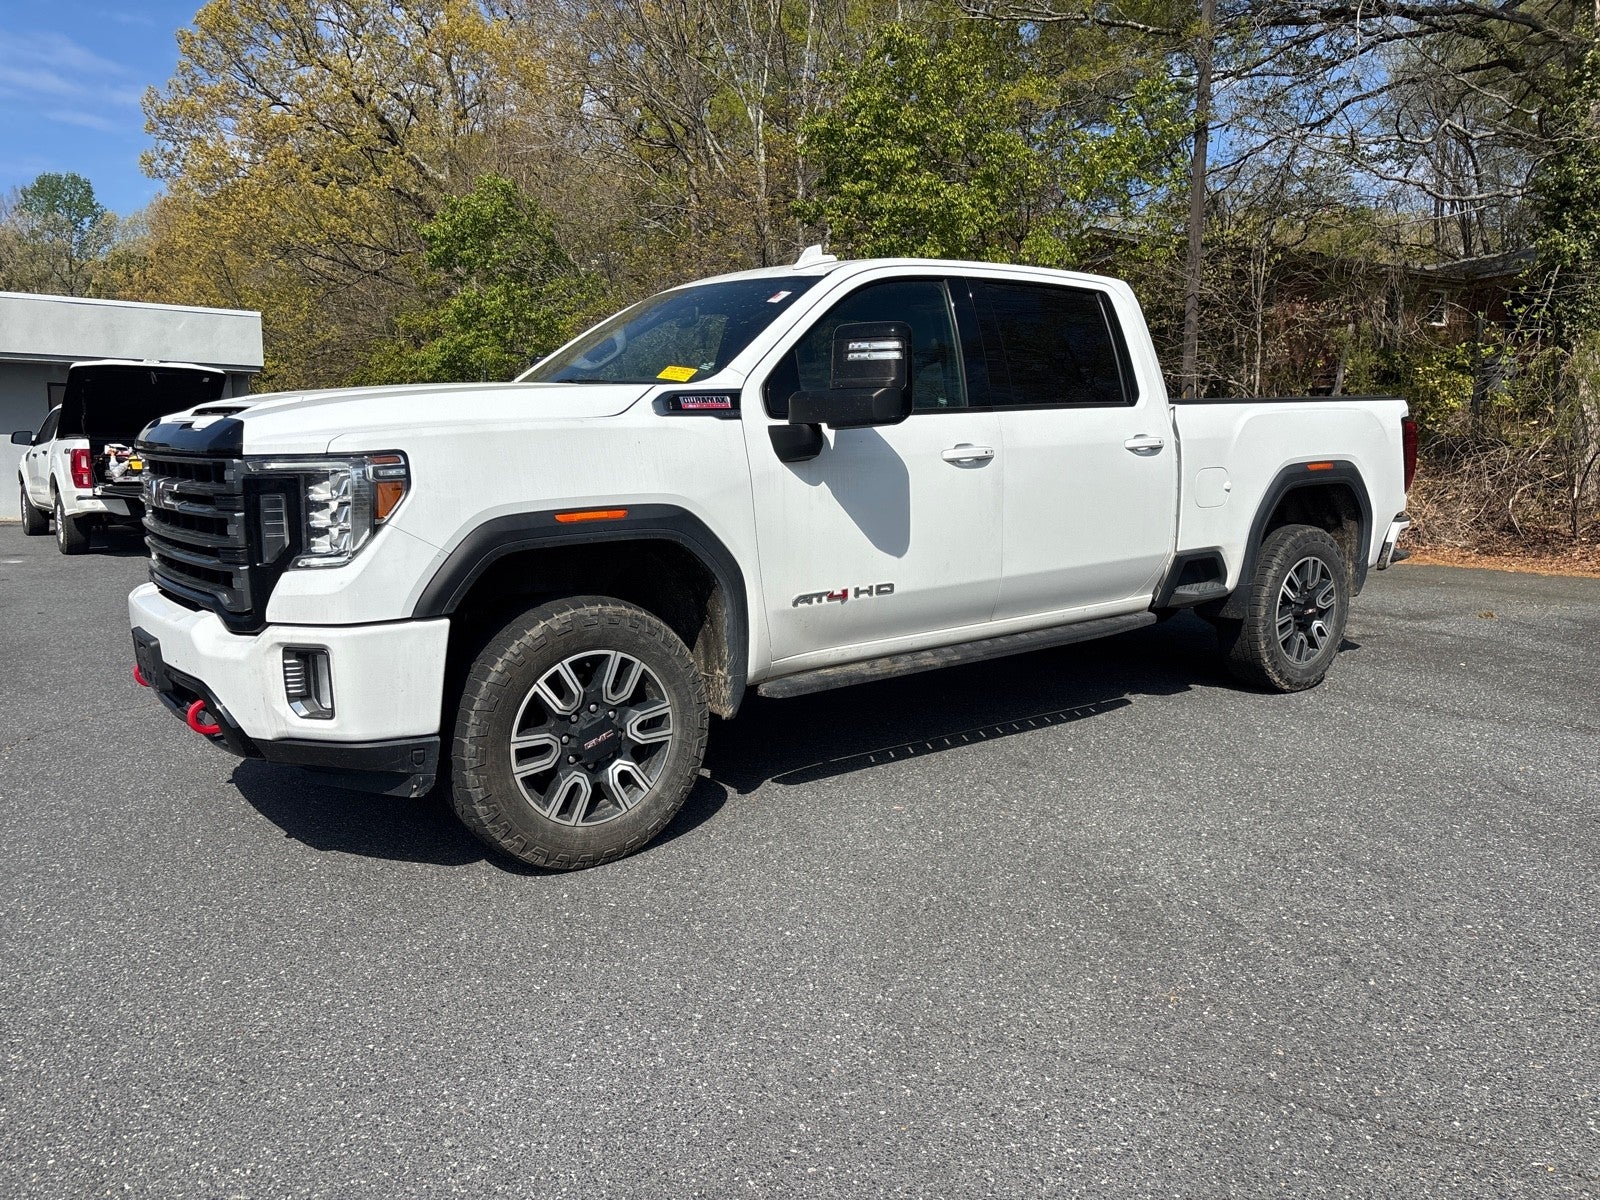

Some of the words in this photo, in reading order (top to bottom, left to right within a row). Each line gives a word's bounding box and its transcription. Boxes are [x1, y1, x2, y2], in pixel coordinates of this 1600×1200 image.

[682, 396, 727, 404] DURAMAX
[792, 588, 848, 608] AT4
[854, 583, 895, 599] HD
[583, 729, 614, 750] GMC
